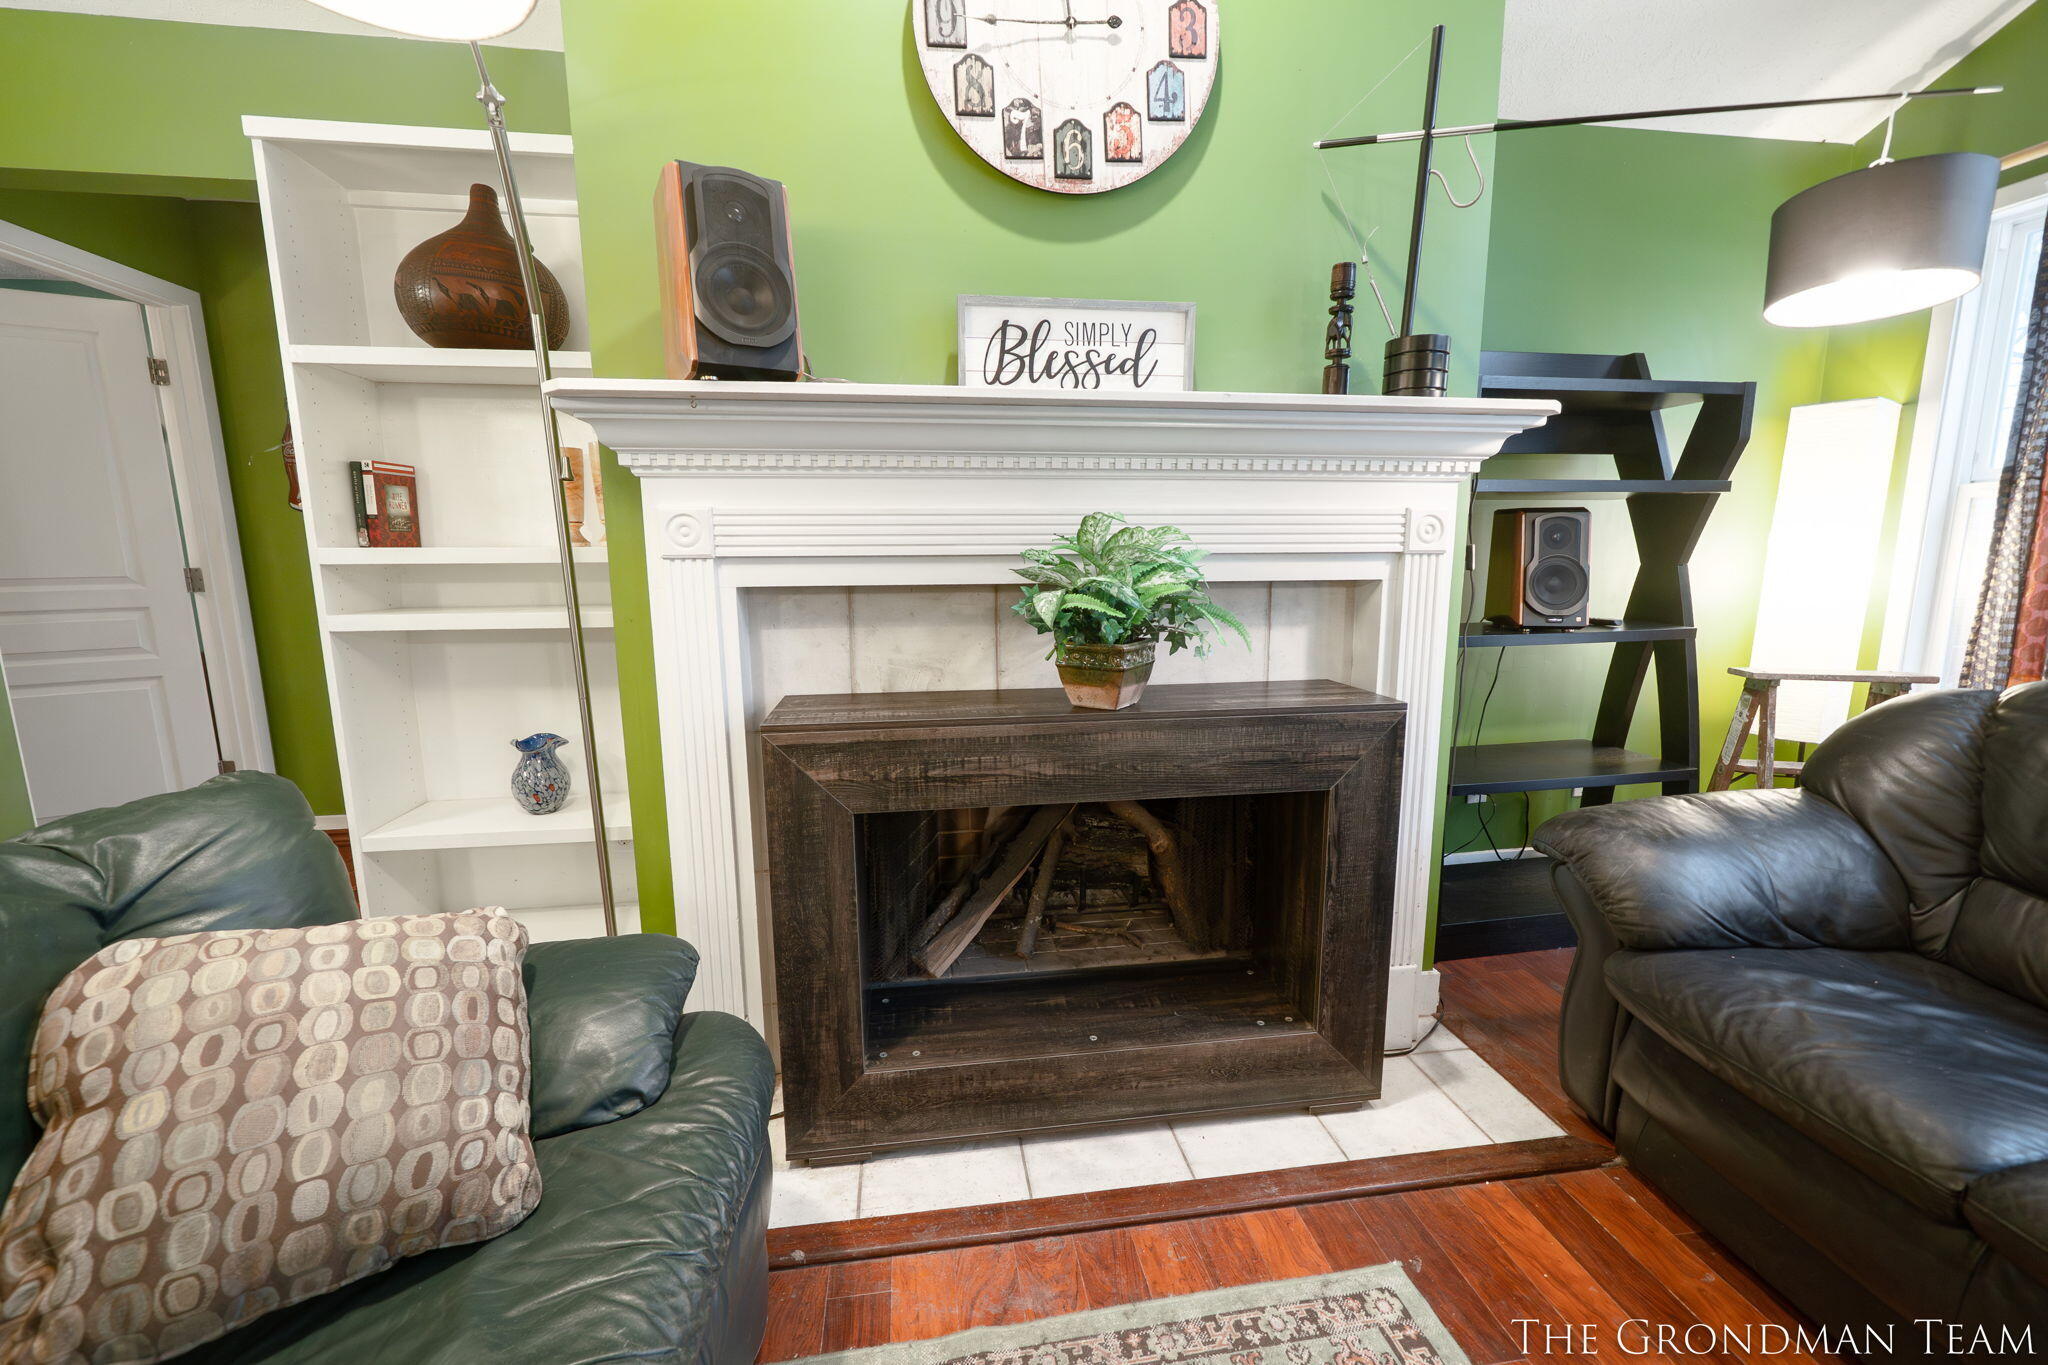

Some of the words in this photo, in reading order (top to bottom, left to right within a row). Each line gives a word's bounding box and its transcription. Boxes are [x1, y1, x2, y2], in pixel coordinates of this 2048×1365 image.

[936, 0, 958, 38] 9
[1179, 7, 1199, 50] 3
[965, 64, 986, 108] 8
[1154, 71, 1178, 113] 4
[1009, 109, 1031, 152] 7
[1063, 129, 1085, 171] 6
[1114, 113, 1135, 155] 5
[983, 319, 1158, 389] Blessed
[1064, 321, 1132, 347] SIMPLY
